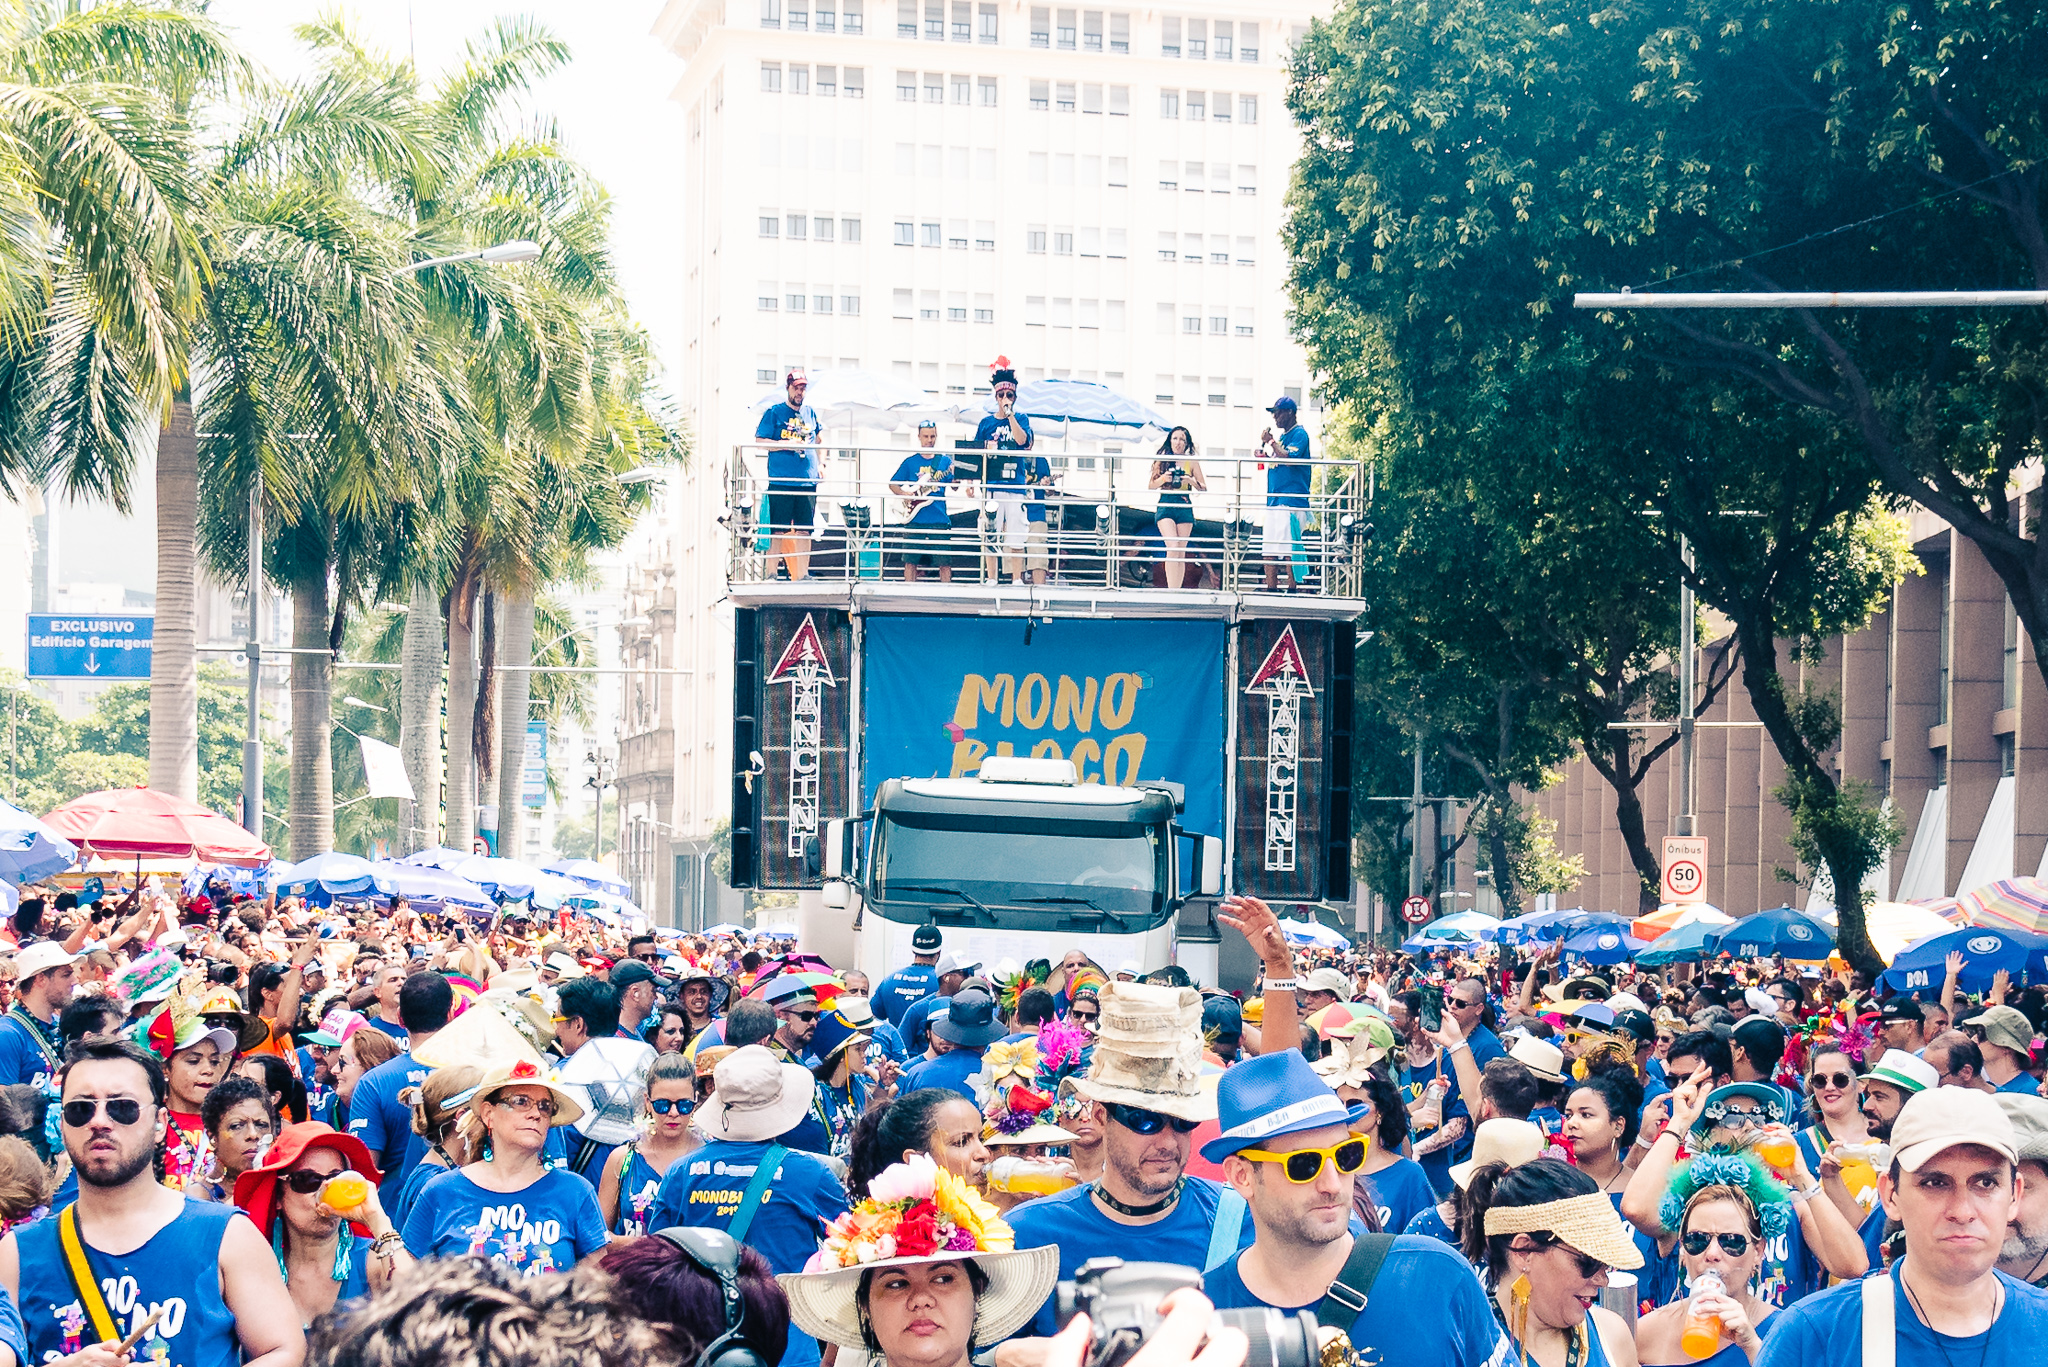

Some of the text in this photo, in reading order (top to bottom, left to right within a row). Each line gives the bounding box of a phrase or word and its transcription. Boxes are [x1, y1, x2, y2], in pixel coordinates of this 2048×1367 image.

[50, 620, 135, 633] EXCLUSIVO
[89, 636, 153, 651] Garagem
[953, 672, 1138, 733] MONO
[1668, 843, 1702, 854] Ônibus
[1675, 868, 1694, 881] 50
[1906, 969, 1929, 988] BOA
[479, 1203, 526, 1231] MO
[522, 1219, 561, 1246] NO
